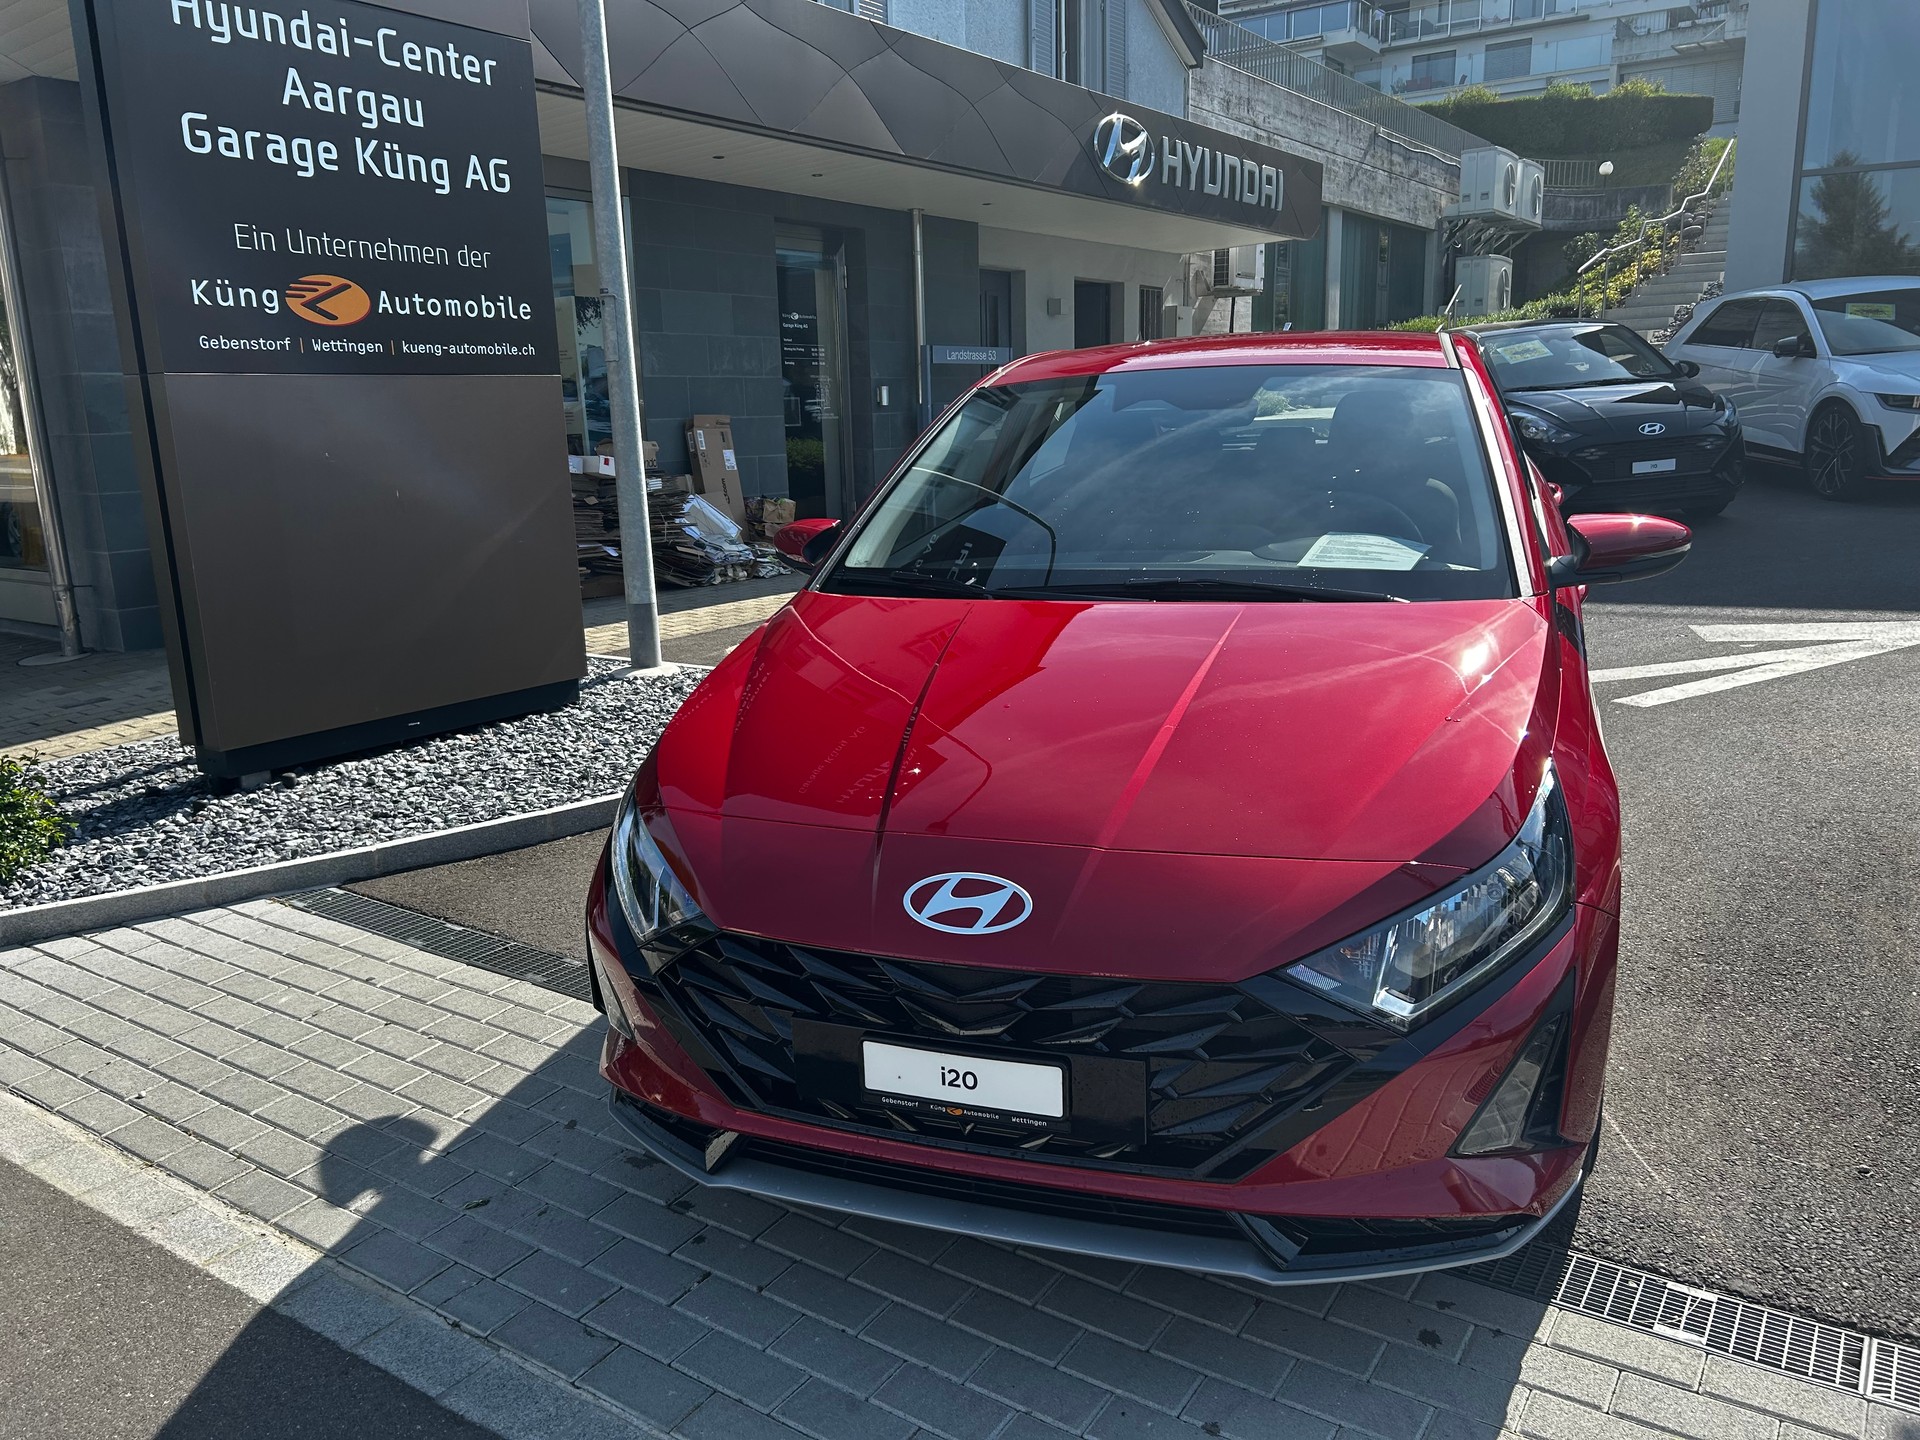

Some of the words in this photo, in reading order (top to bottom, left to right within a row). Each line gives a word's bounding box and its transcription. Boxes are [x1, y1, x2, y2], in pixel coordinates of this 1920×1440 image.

[170, 0, 497, 87] Hyundai-Center
[282, 67, 425, 130] Aargau
[181, 111, 339, 178] Garage
[354, 136, 451, 195] Küng
[465, 154, 511, 193] AG
[1161, 135, 1284, 211] HYUNDAI
[234, 223, 276, 252] Ein
[286, 227, 449, 266] Unternehmen
[457, 244, 491, 269] der
[190, 279, 280, 315] Küng
[378, 290, 531, 320] Automobile
[199, 335, 291, 351] Gebenstorf
[311, 338, 384, 355] Wettingen
[401, 340, 536, 357] kueng-automobile.ch
[946, 349, 987, 361] Landstrasse
[987, 350, 997, 361] 53
[940, 1066, 978, 1091] i20
[881, 1096, 919, 1107] Gebenstorf
[930, 1104, 946, 1113] Küng
[963, 1109, 1000, 1120] Automobile
[1011, 1116, 1047, 1127] Wettingen
